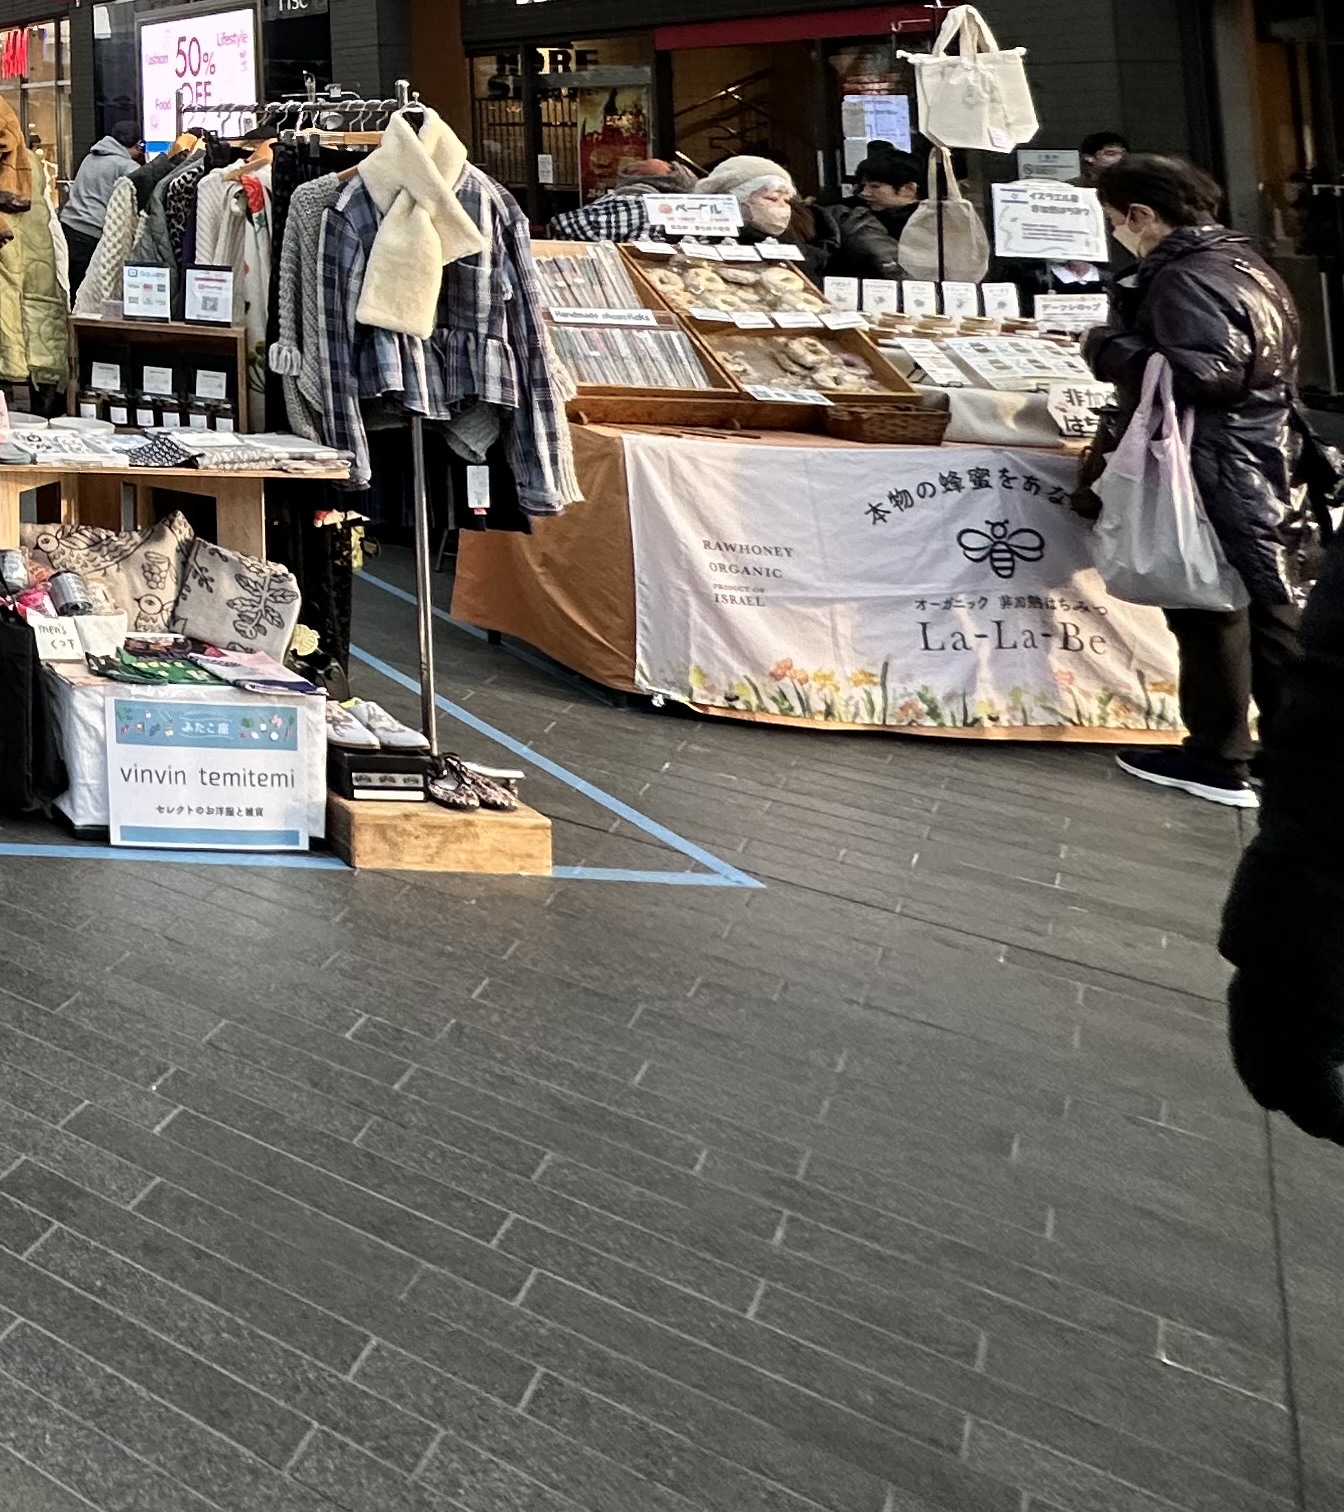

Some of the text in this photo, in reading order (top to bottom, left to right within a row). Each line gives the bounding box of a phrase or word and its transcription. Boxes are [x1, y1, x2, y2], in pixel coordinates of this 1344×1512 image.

[175, 36, 216, 78] 50%
[864, 466, 1074, 525] 本物の蜂蜜をあな
[702, 539, 794, 558] RAWHONEY
[708, 561, 783, 579] ORGANIC
[713, 593, 766, 607] ISRAEL
[914, 596, 989, 611] オーガニック
[916, 619, 1108, 656] La-La-Be
[181, 721, 230, 735] ふたこ座
[120, 763, 296, 789] vinvin temitemi
[155, 804, 264, 818] セレクトのお洋服と雑貨
